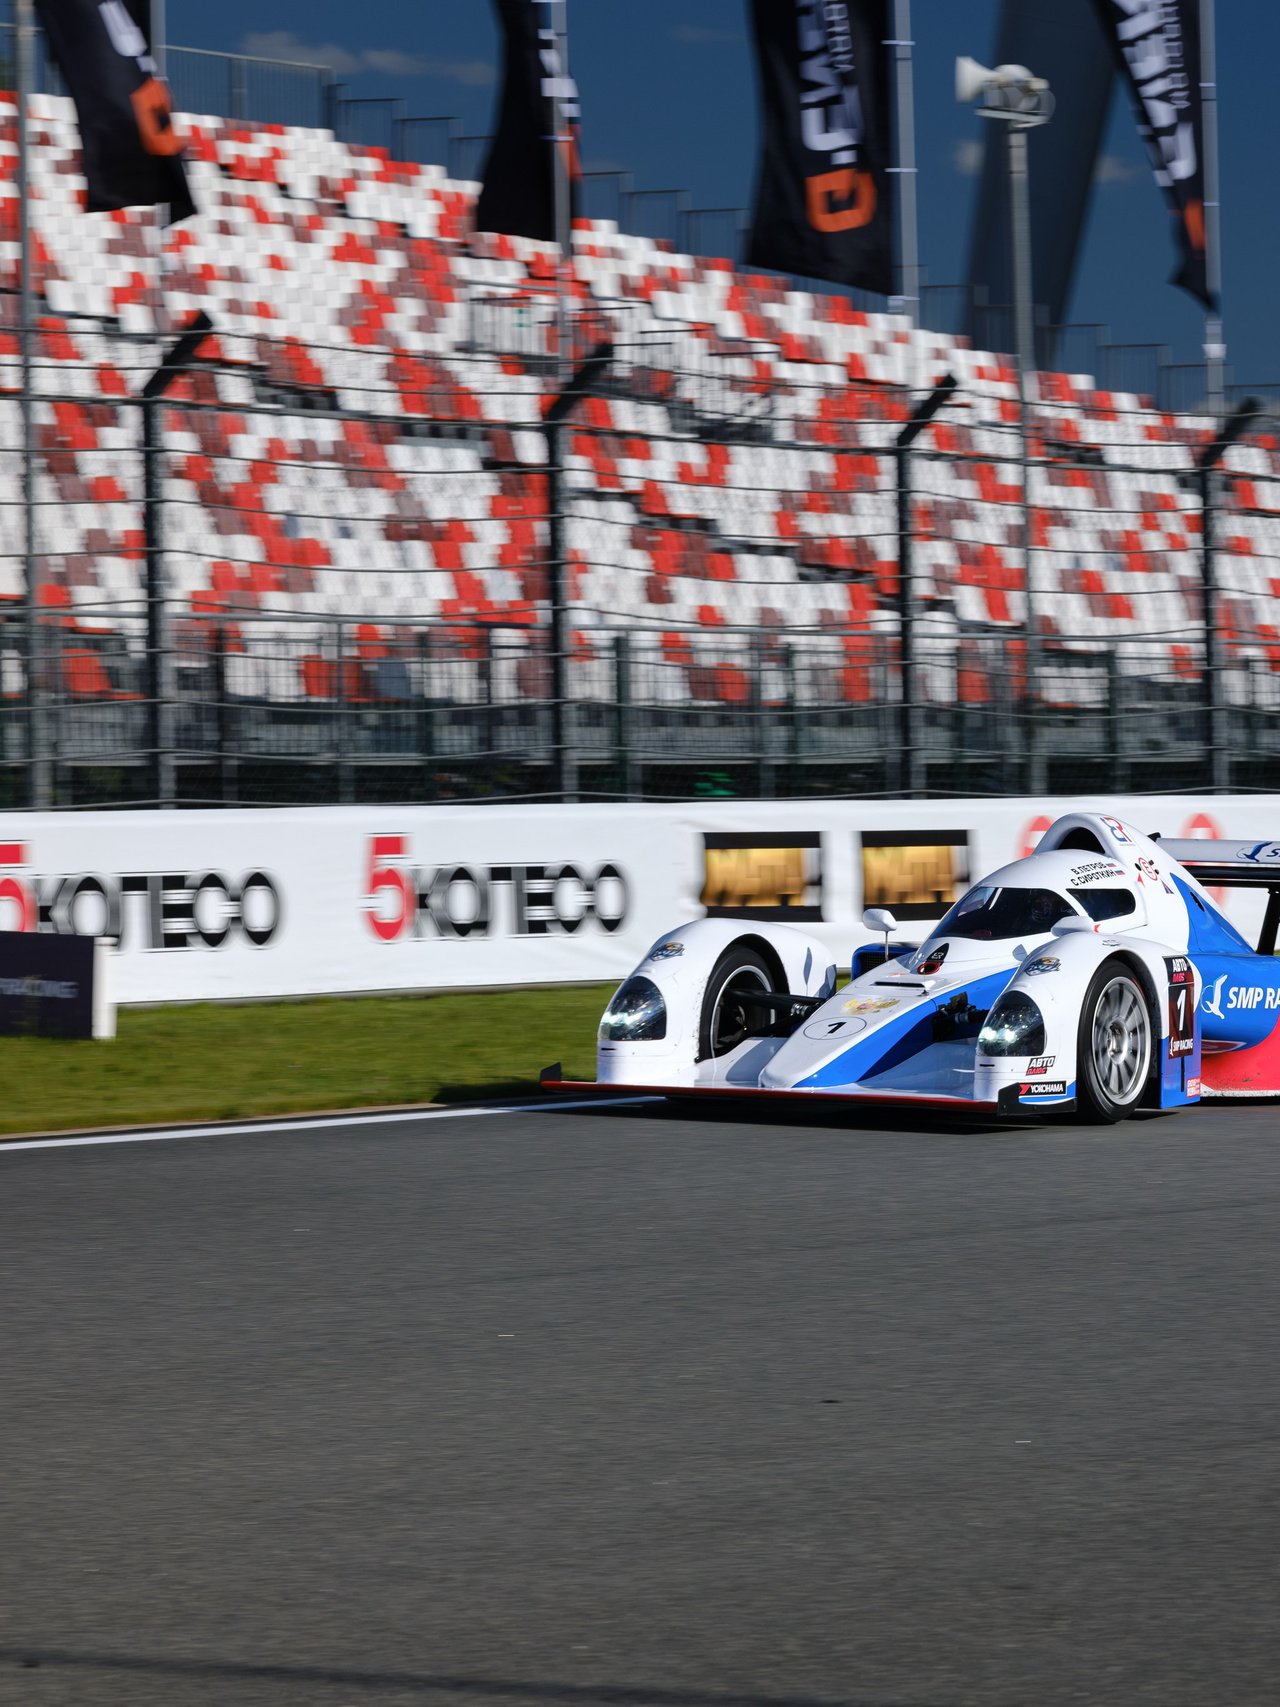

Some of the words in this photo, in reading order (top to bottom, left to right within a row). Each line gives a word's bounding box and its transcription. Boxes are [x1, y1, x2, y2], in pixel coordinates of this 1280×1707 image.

[1227, 987, 1264, 1009] SMP
[1176, 989, 1187, 1031] 1
[827, 1021, 848, 1035] 1
[1029, 1057, 1055, 1068] АВТО
[1030, 1083, 1064, 1093] YOKOHAMA
